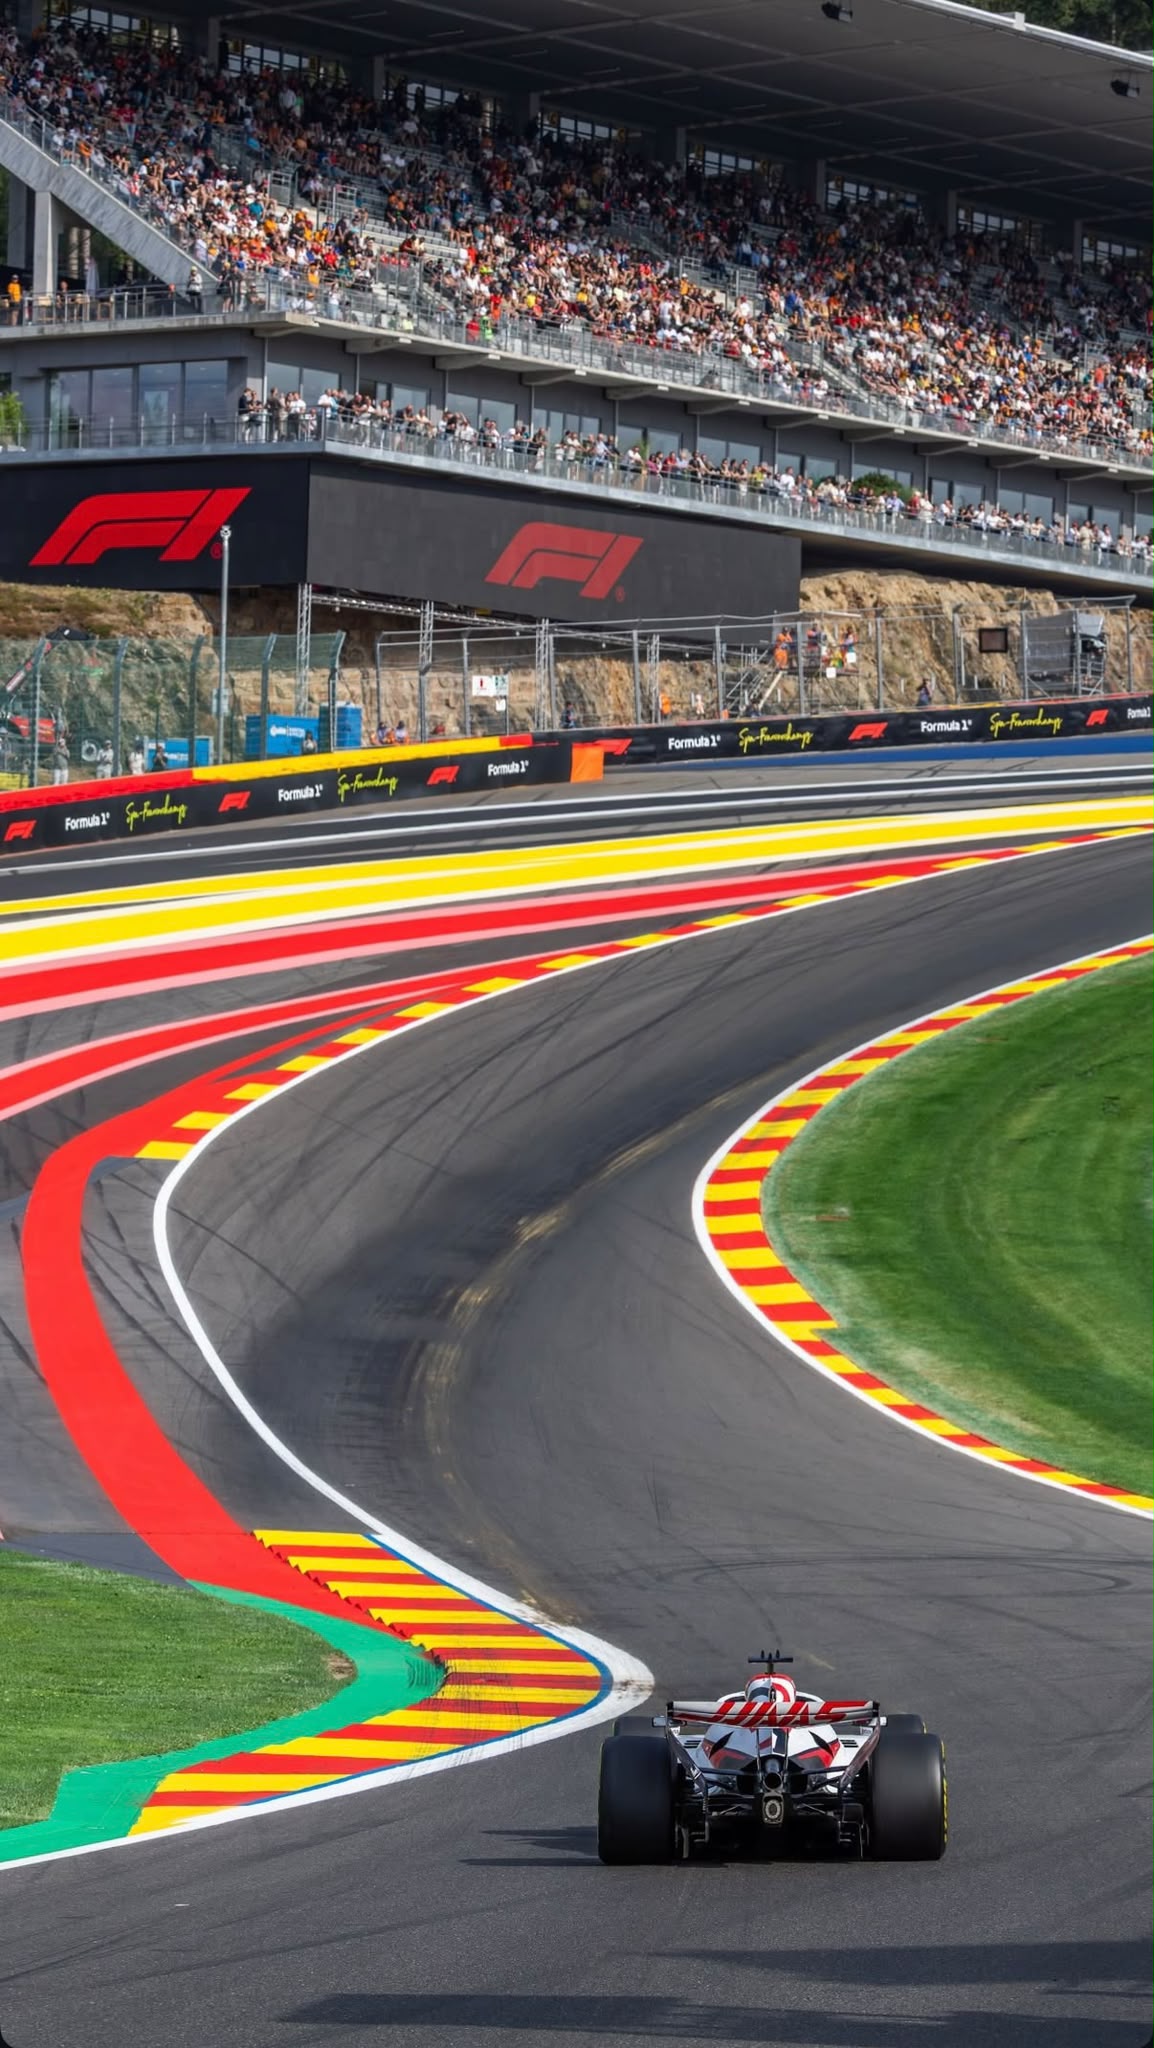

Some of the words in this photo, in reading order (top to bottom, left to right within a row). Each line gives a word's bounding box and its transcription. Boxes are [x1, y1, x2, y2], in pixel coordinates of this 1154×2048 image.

[28, 487, 252, 566] F1
[484, 520, 644, 601] F1
[848, 721, 888, 741] F1
[920, 719, 960, 733] Formula
[668, 735, 710, 750] Formula
[487, 761, 519, 777] Formula
[278, 785, 315, 802] Formula
[65, 815, 100, 831] Formula
